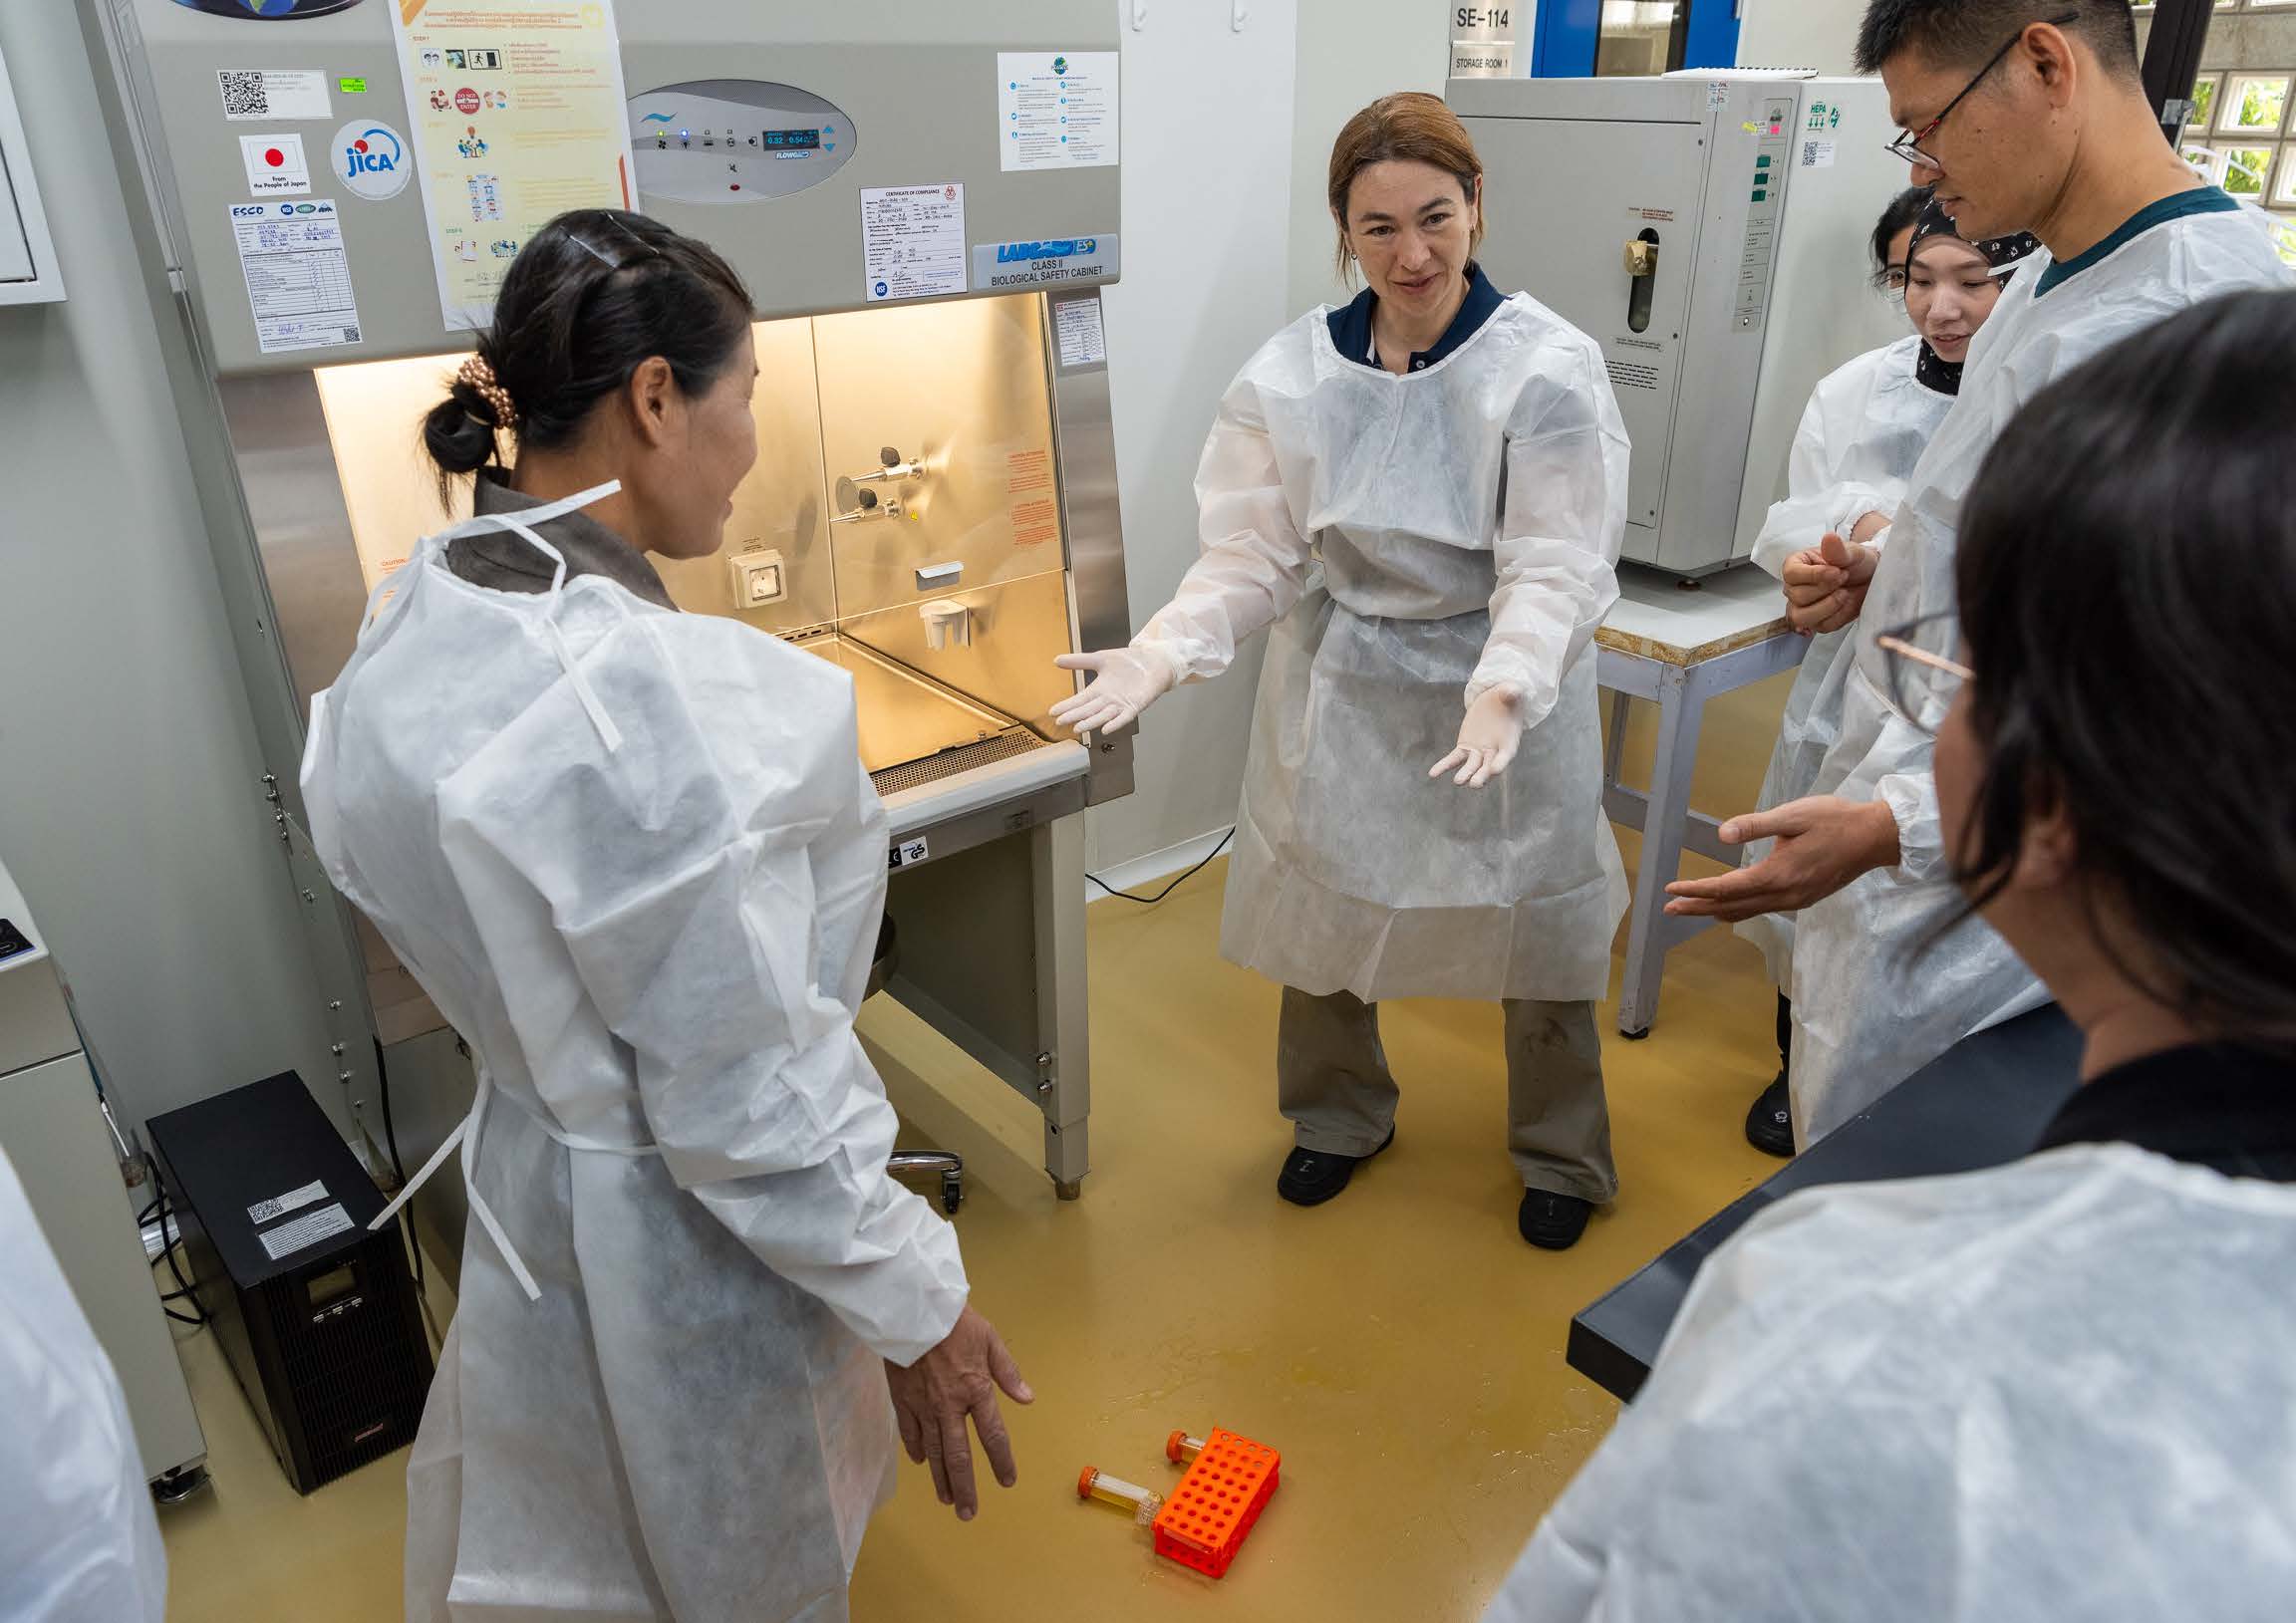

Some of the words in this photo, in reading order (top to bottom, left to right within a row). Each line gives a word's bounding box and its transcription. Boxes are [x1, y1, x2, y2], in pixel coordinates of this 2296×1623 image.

[1457, 8, 1509, 28] SE-114
[1456, 58, 1483, 69] STORAGE
[1485, 58, 1503, 69] ROOM
[1810, 104, 1827, 115] HEPA
[233, 206, 264, 217] ESCO
[1031, 259, 1057, 271] CLASS
[1058, 259, 1063, 269] II
[992, 273, 1039, 287] BIOLOGICAL
[1040, 269, 1070, 281] SAFETY
[1070, 265, 1103, 278] CABINET
